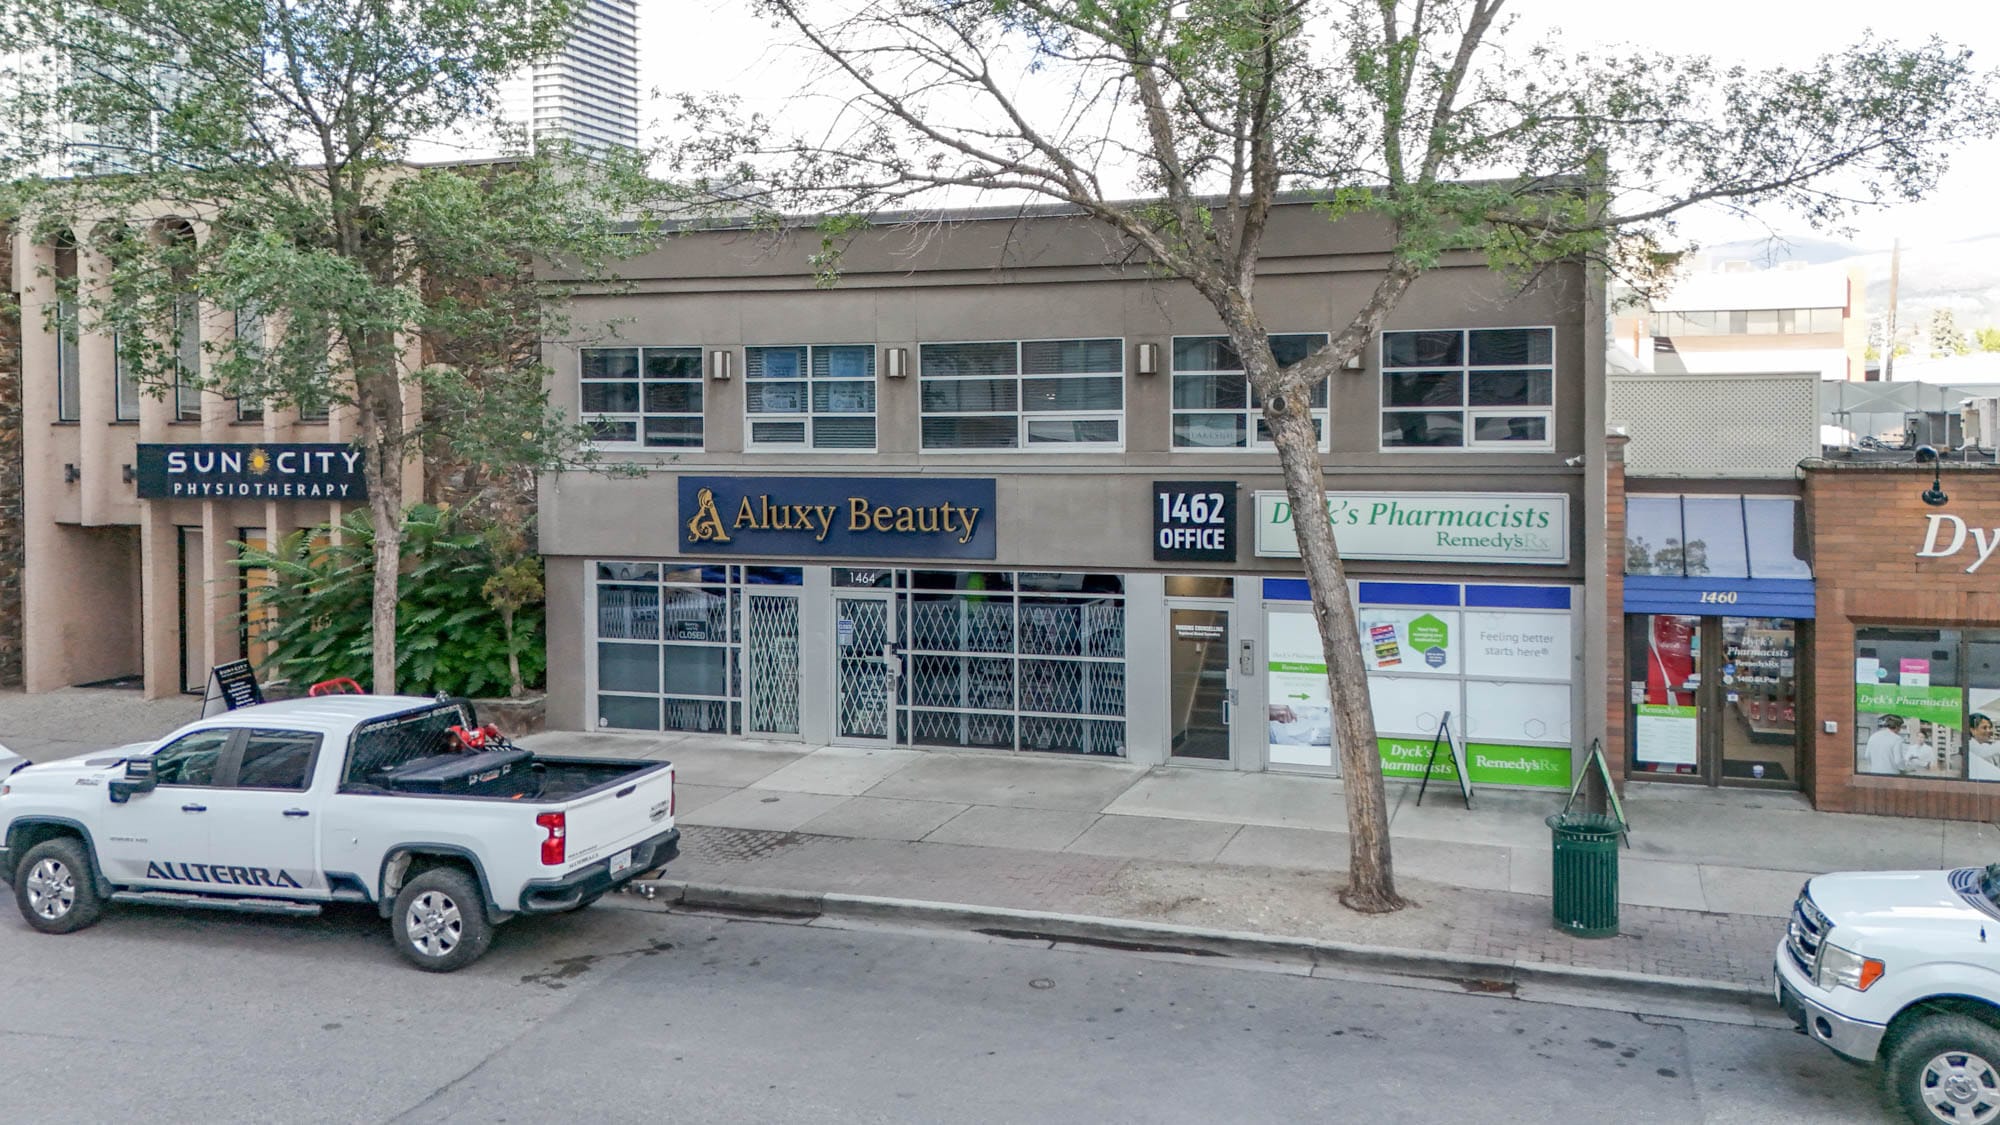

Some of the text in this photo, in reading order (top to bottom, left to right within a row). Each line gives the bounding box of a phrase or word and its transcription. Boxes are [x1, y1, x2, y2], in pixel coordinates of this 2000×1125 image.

[168, 452, 361, 473] SUN CITY
[173, 483, 349, 496] PHYSIOTHERAPY
[1160, 493, 1225, 523] 1462
[733, 495, 979, 544] Aluxy Beauty
[1271, 500, 1550, 531] Dk's Pharmacists
[1160, 528, 1225, 549] OFFICE
[850, 572, 875, 584] 1464
[1700, 591, 1738, 604] 1460
[679, 631, 706, 640] CLOSED
[1480, 631, 1554, 644] Feeling better
[1484, 648, 1513, 656] starts
[1727, 646, 1790, 658] Pharmacists
[1390, 744, 1433, 760] Dyck's
[146, 860, 304, 888] ALLTERRA
